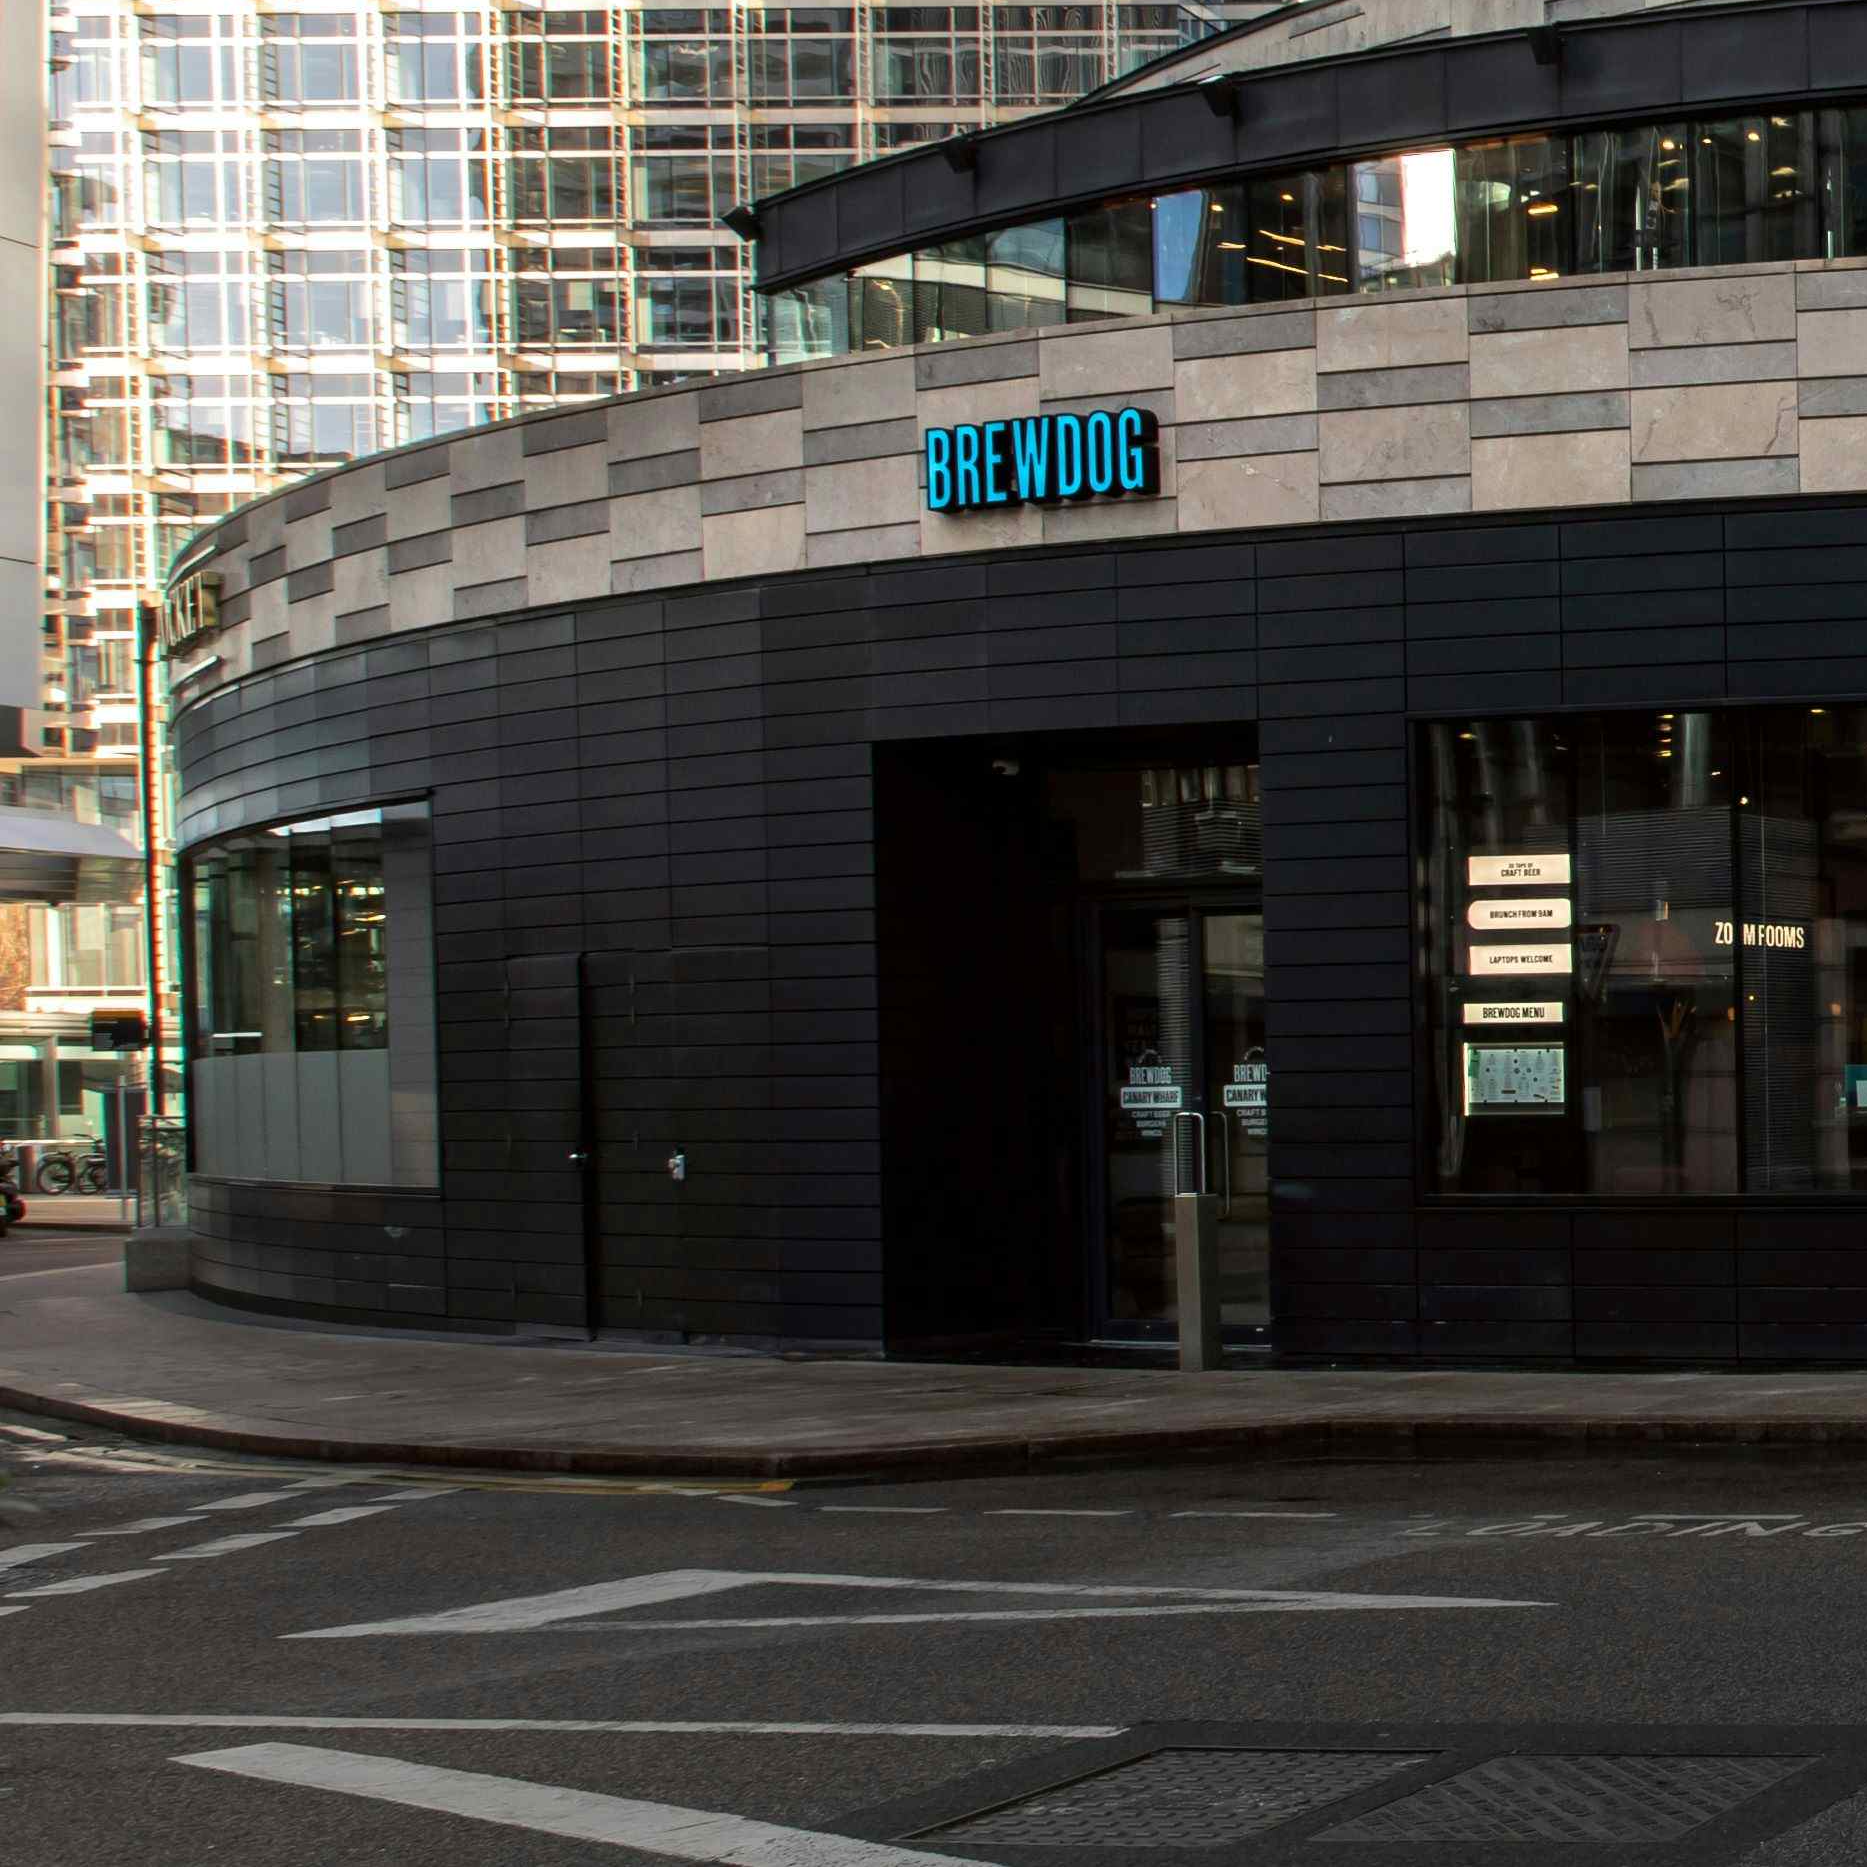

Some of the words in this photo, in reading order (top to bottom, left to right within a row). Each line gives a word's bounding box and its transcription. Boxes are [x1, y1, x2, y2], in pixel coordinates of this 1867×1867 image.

[926, 407, 1150, 512] BREWDOG
[1501, 869, 1521, 877] CRAFT
[1523, 868, 1541, 877] BEER
[1490, 910, 1518, 919] BRUNCH
[1518, 910, 1536, 918] FROM
[1714, 921, 1756, 945] ZOM
[1489, 956, 1519, 964] LAPTOPS
[1520, 954, 1553, 963] WELCOME
[1482, 1007, 1520, 1019] BREWDOG
[1522, 1006, 1545, 1018] MENU
[1129, 1067, 1172, 1084] BREWDOG
[1123, 1091, 1151, 1103] CANARY
[1226, 1089, 1257, 1103] CANARY
